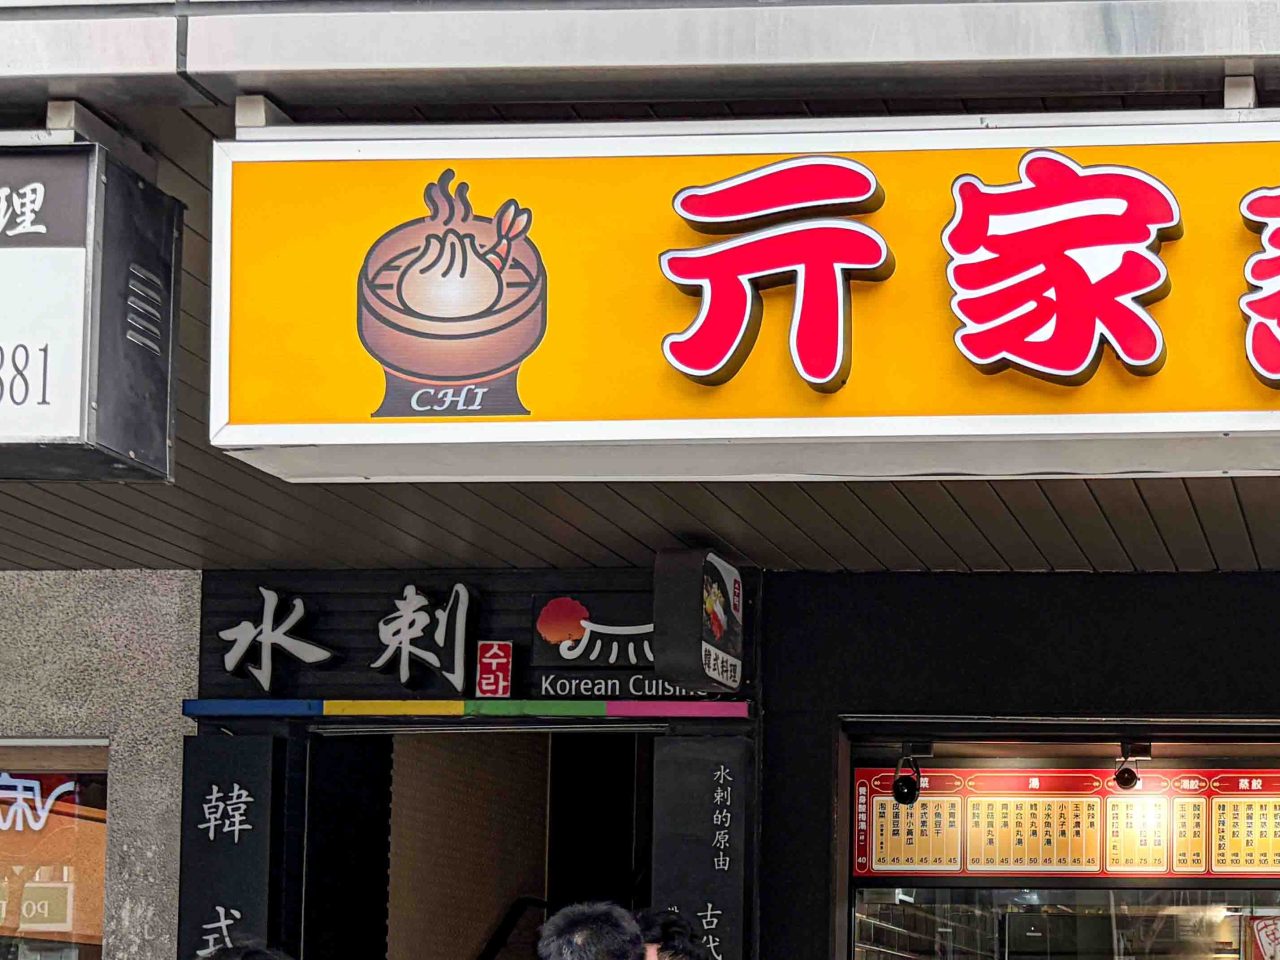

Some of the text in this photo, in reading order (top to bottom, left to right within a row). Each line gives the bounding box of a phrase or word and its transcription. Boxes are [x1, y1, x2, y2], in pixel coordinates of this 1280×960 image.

[0, 343, 51, 405] 81
[410, 385, 489, 411] CHI
[480, 643, 510, 695] 수라
[541, 675, 708, 696] Korean Cuis
[1238, 778, 1263, 790] 蒸餃
